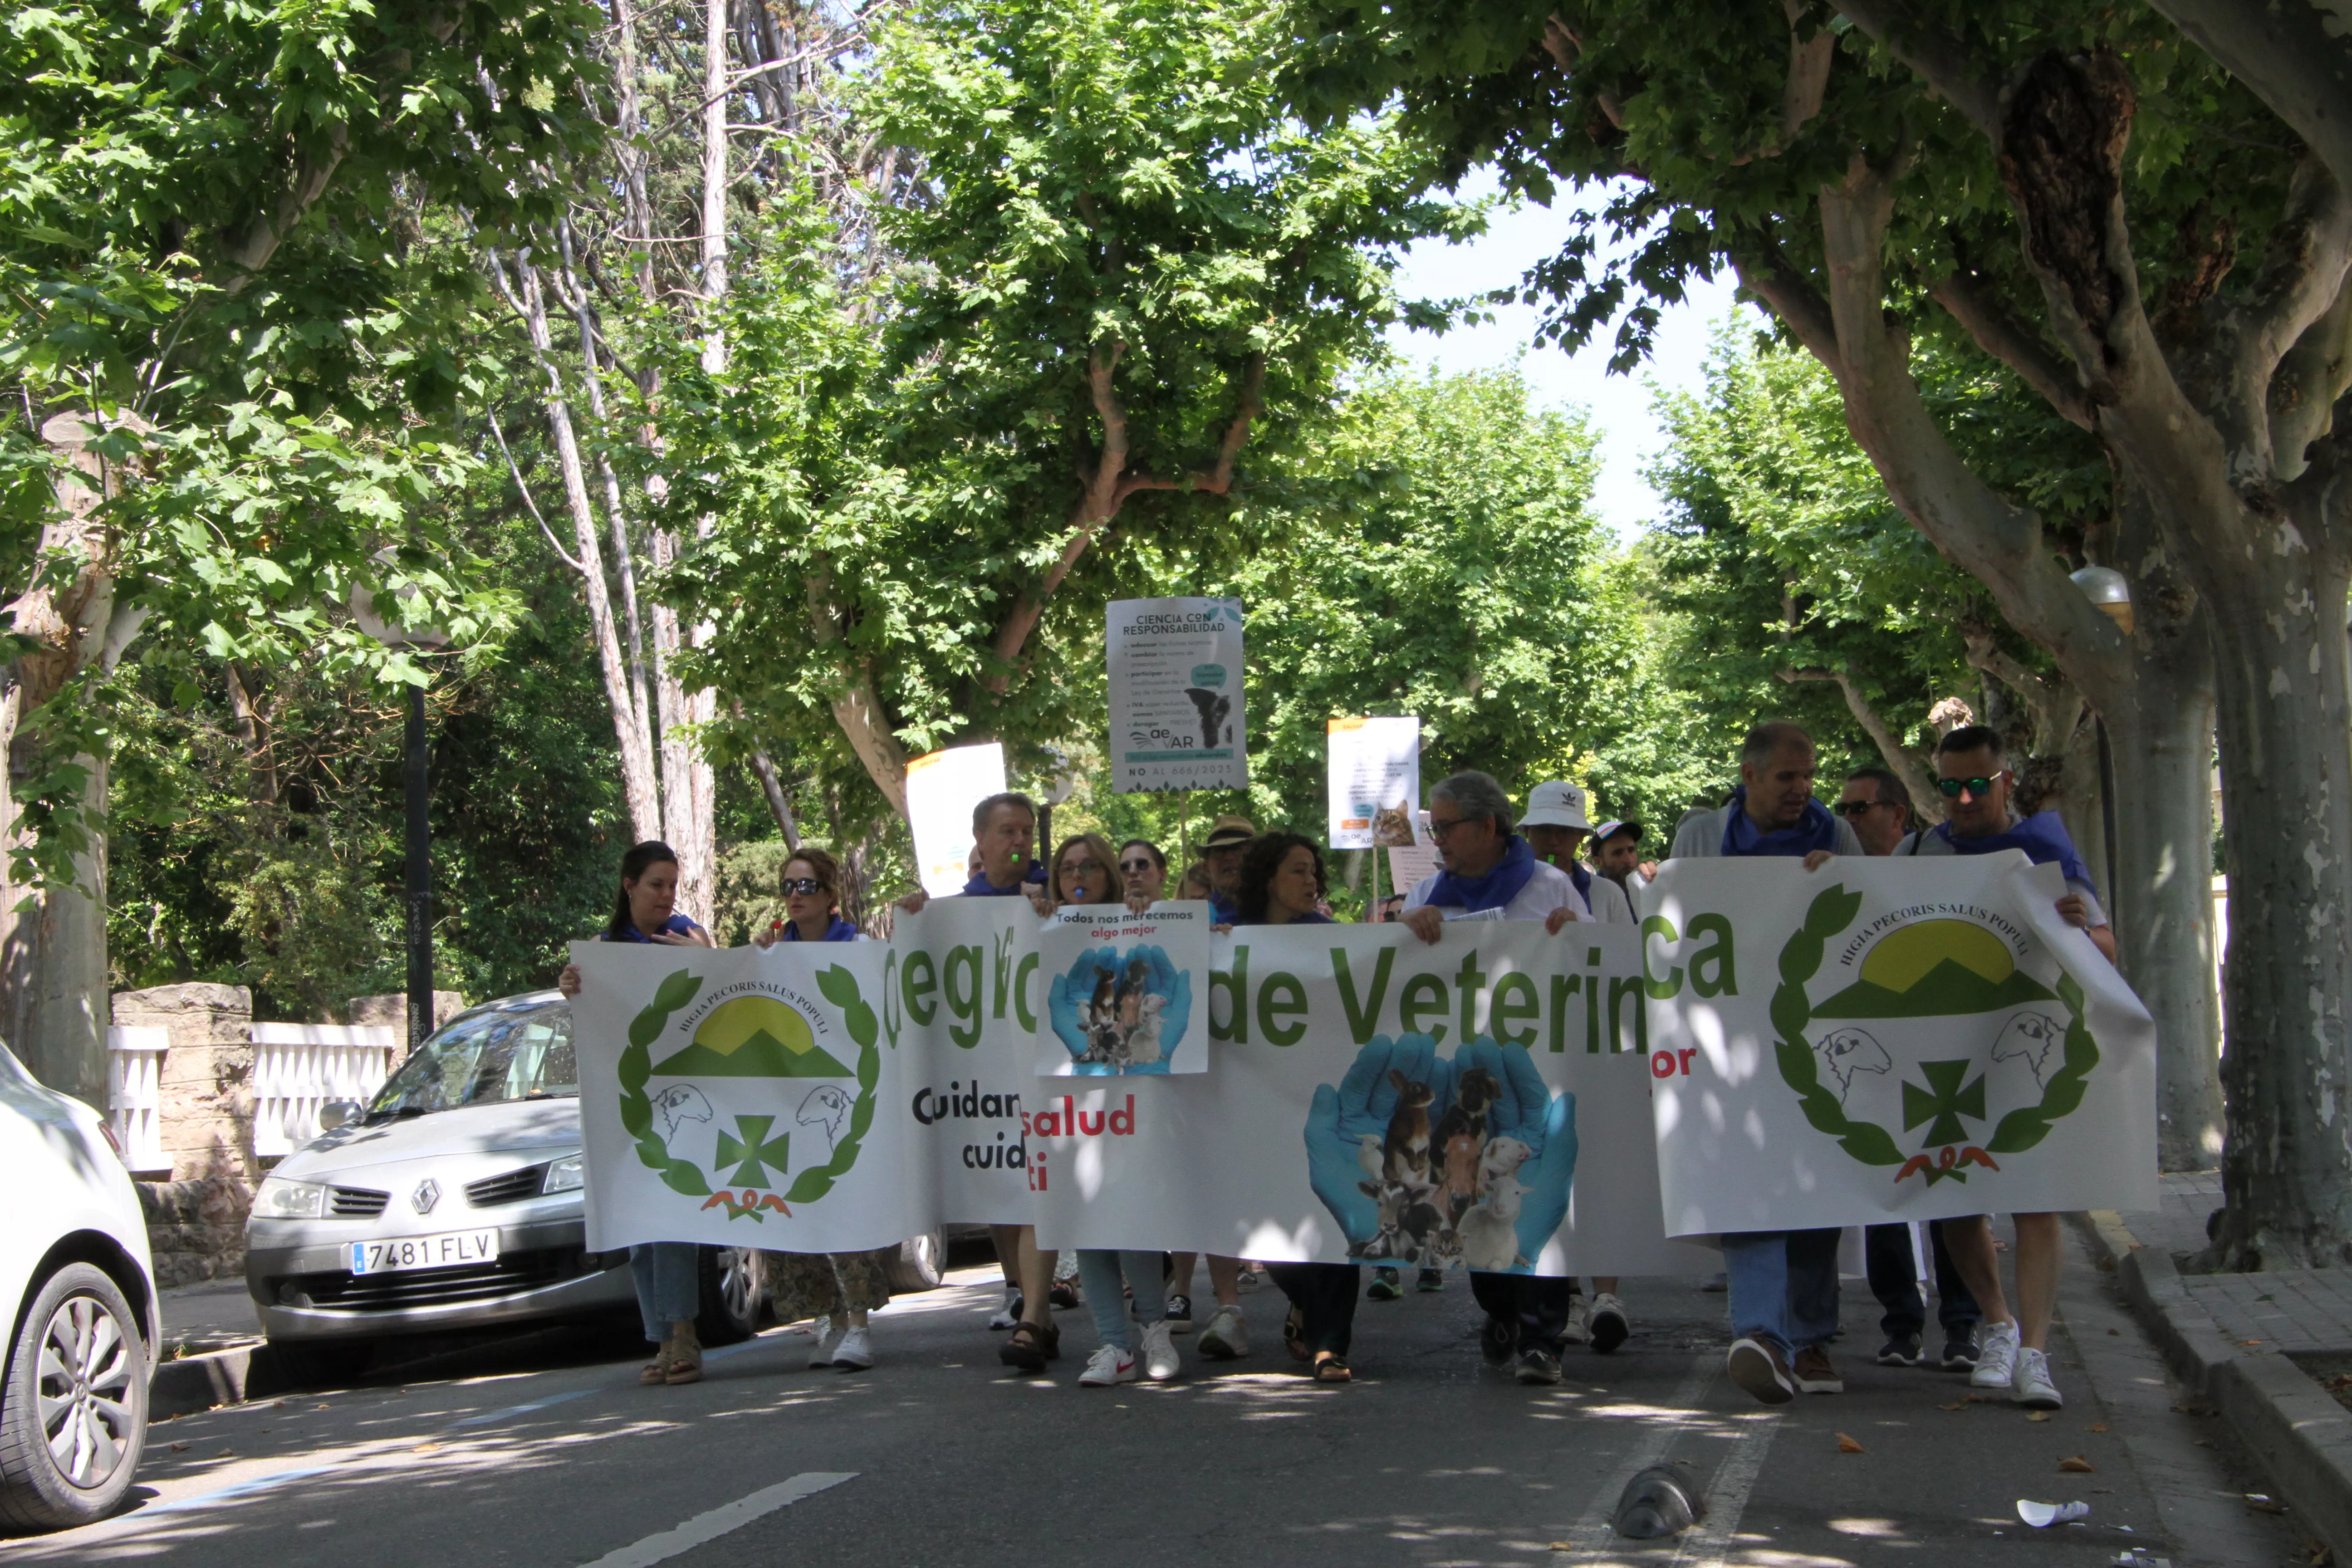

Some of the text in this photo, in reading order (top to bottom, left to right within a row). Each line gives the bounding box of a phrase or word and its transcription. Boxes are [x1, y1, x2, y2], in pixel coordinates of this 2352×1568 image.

[1137, 614, 1182, 624] CIENCIA
[1123, 623, 1225, 635] RESPONSABILIDAD
[1131, 670, 1163, 678] participar
[1151, 729, 1170, 739] ae
[1129, 768, 1146, 776] NO
[1172, 764, 1231, 776] 666/2023
[1056, 911, 1193, 924] Todos nos merecemos
[1092, 924, 1157, 940] algo mejor
[1840, 903, 2028, 966] HIGIA PECORIS SALUS POPULI
[1209, 945, 1308, 1047] de
[707, 981, 756, 1005] PECORIS
[759, 982, 796, 1000] SALUS
[795, 996, 828, 1035] POPULI
[1022, 1094, 1135, 1137] salud
[369, 1241, 429, 1269] 7481
[441, 1234, 489, 1262] FLV
